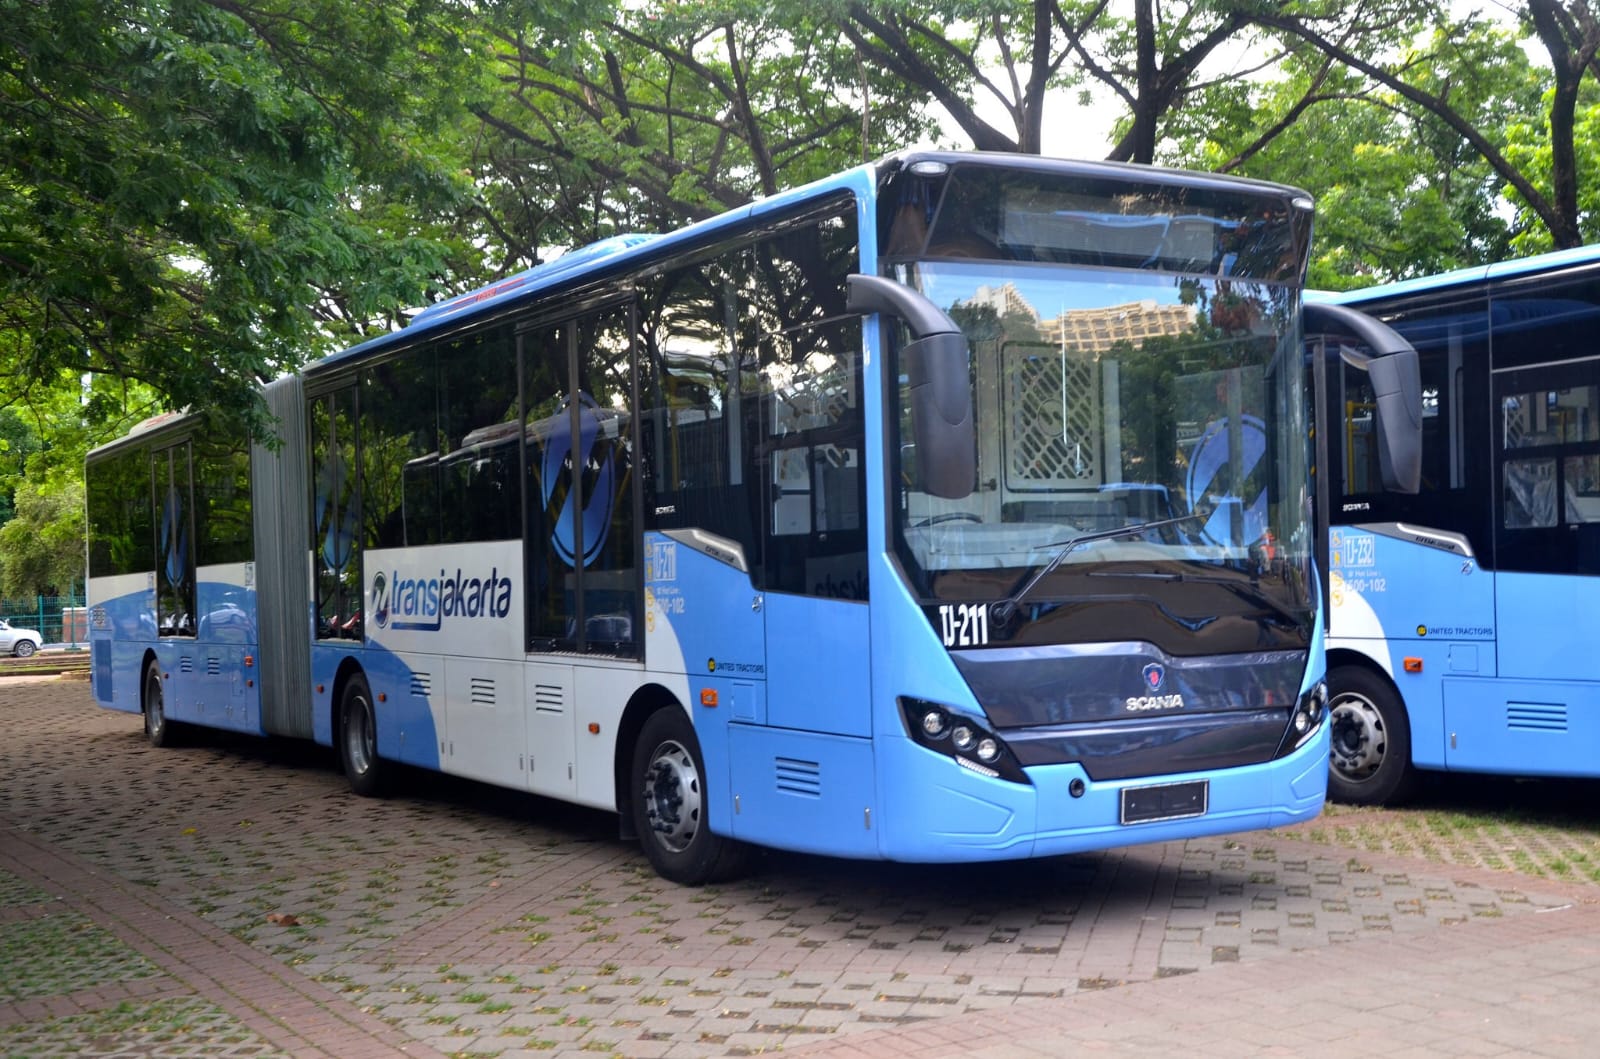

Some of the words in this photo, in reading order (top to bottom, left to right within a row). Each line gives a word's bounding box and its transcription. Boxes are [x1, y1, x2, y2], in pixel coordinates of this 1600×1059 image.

[1346, 537, 1372, 564] TJ-232
[391, 567, 512, 631] transjakarta
[939, 603, 988, 647] TJ-211
[1428, 627, 1453, 635] UNITED
[1455, 627, 1493, 636] TRACTORS
[1126, 694, 1184, 711] SCANIA
